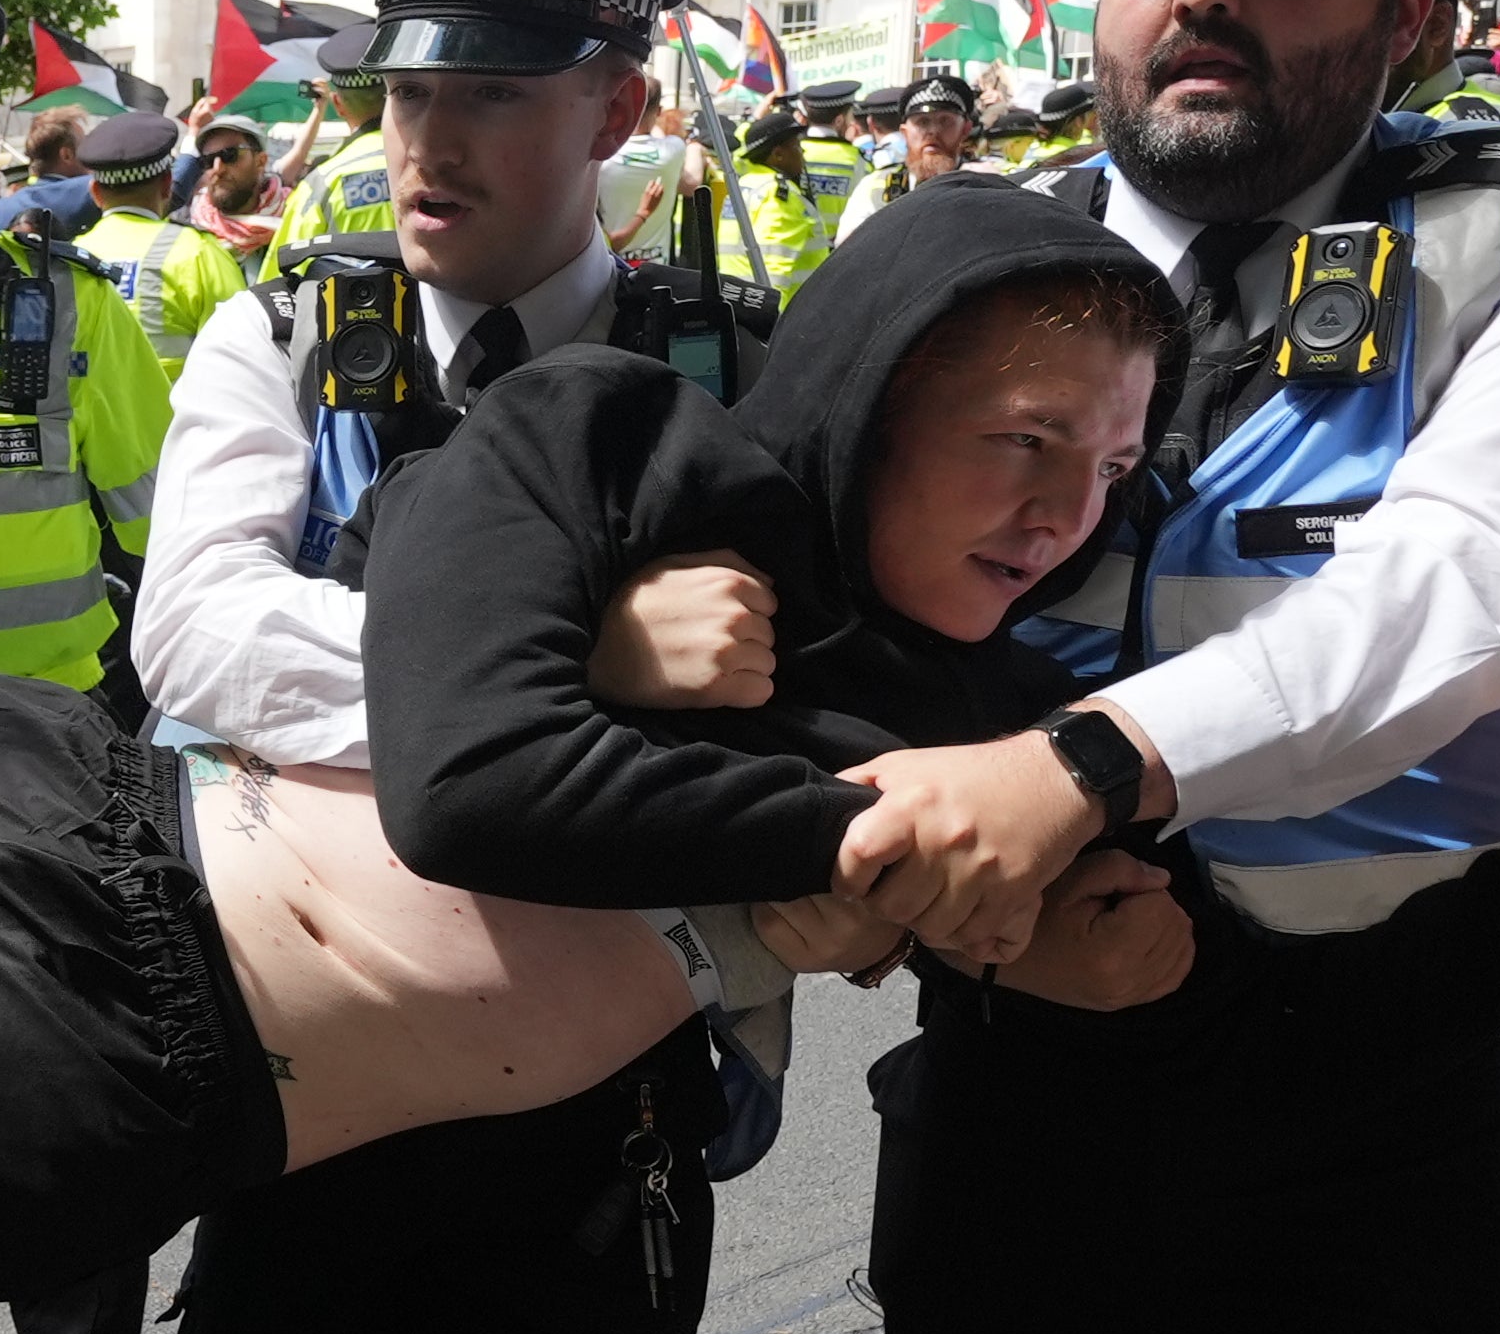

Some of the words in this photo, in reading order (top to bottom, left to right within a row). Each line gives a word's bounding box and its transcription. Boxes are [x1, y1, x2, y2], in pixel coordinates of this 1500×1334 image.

[789, 25, 889, 63] nternational
[1307, 353, 1337, 365] AXON
[352, 387, 377, 396] AXON
[0, 451, 40, 464] OFFICER
[1305, 531, 1335, 544] COLL
[663, 918, 713, 978] LONSDALE
